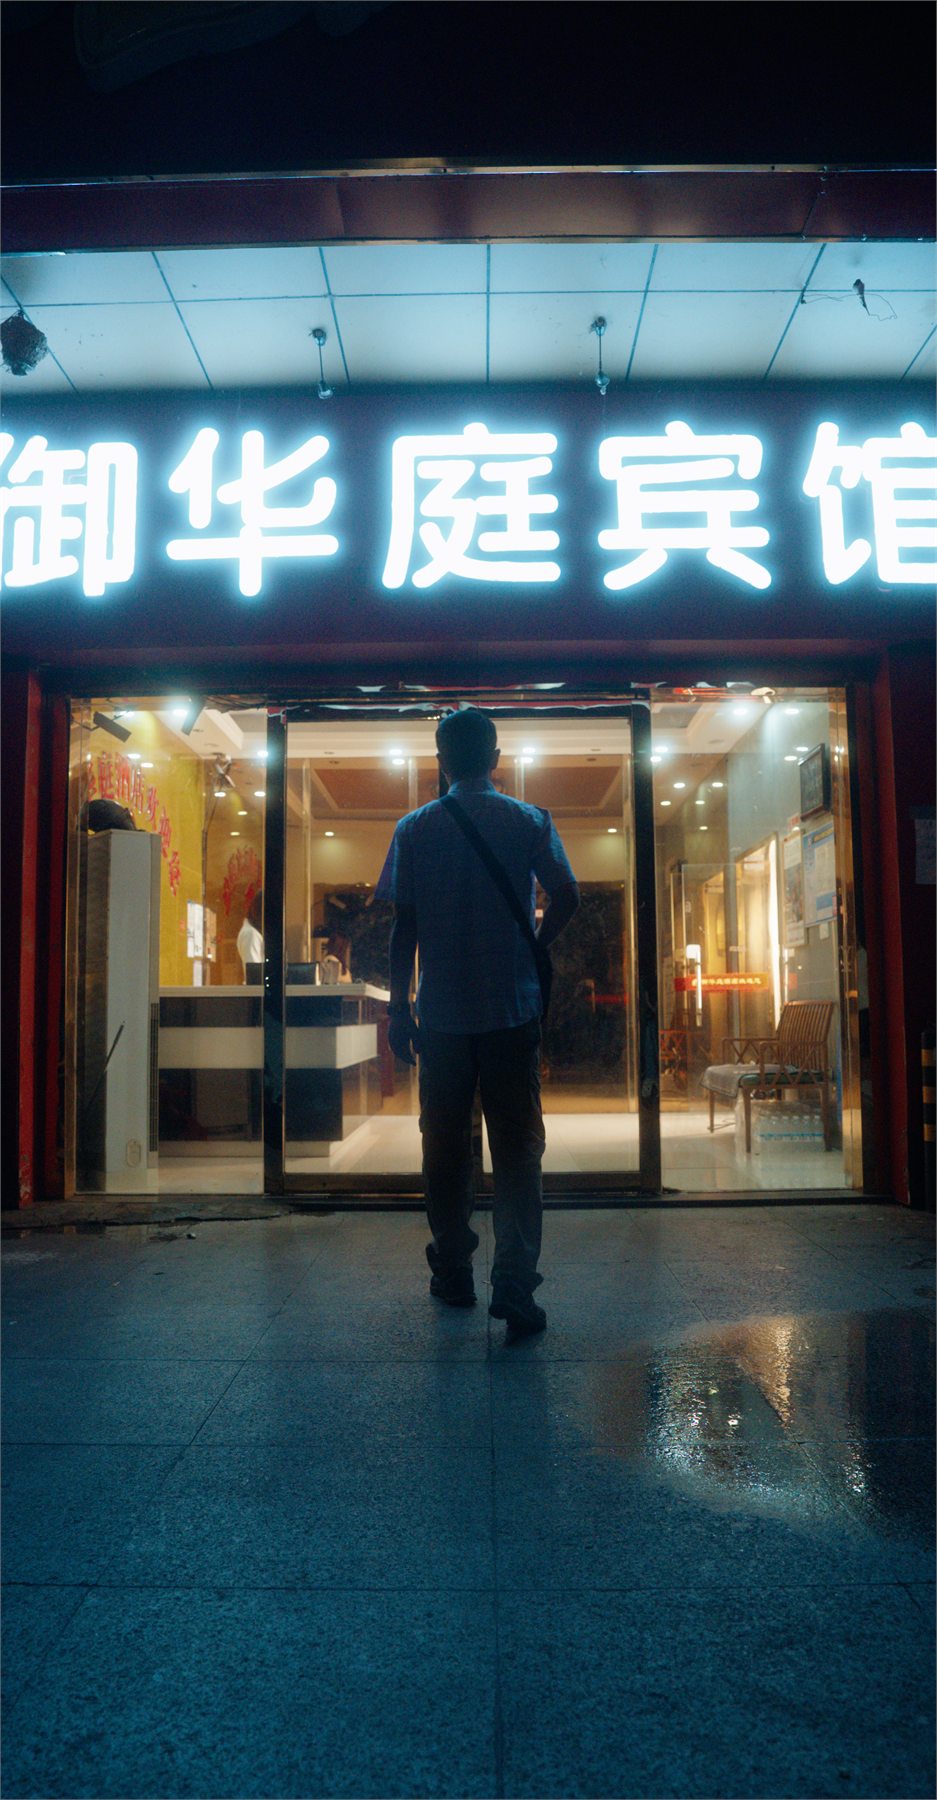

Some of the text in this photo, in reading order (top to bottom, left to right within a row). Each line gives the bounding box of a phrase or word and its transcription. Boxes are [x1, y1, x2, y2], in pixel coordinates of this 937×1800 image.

[0, 421, 936, 597] 御华庭宾馆
